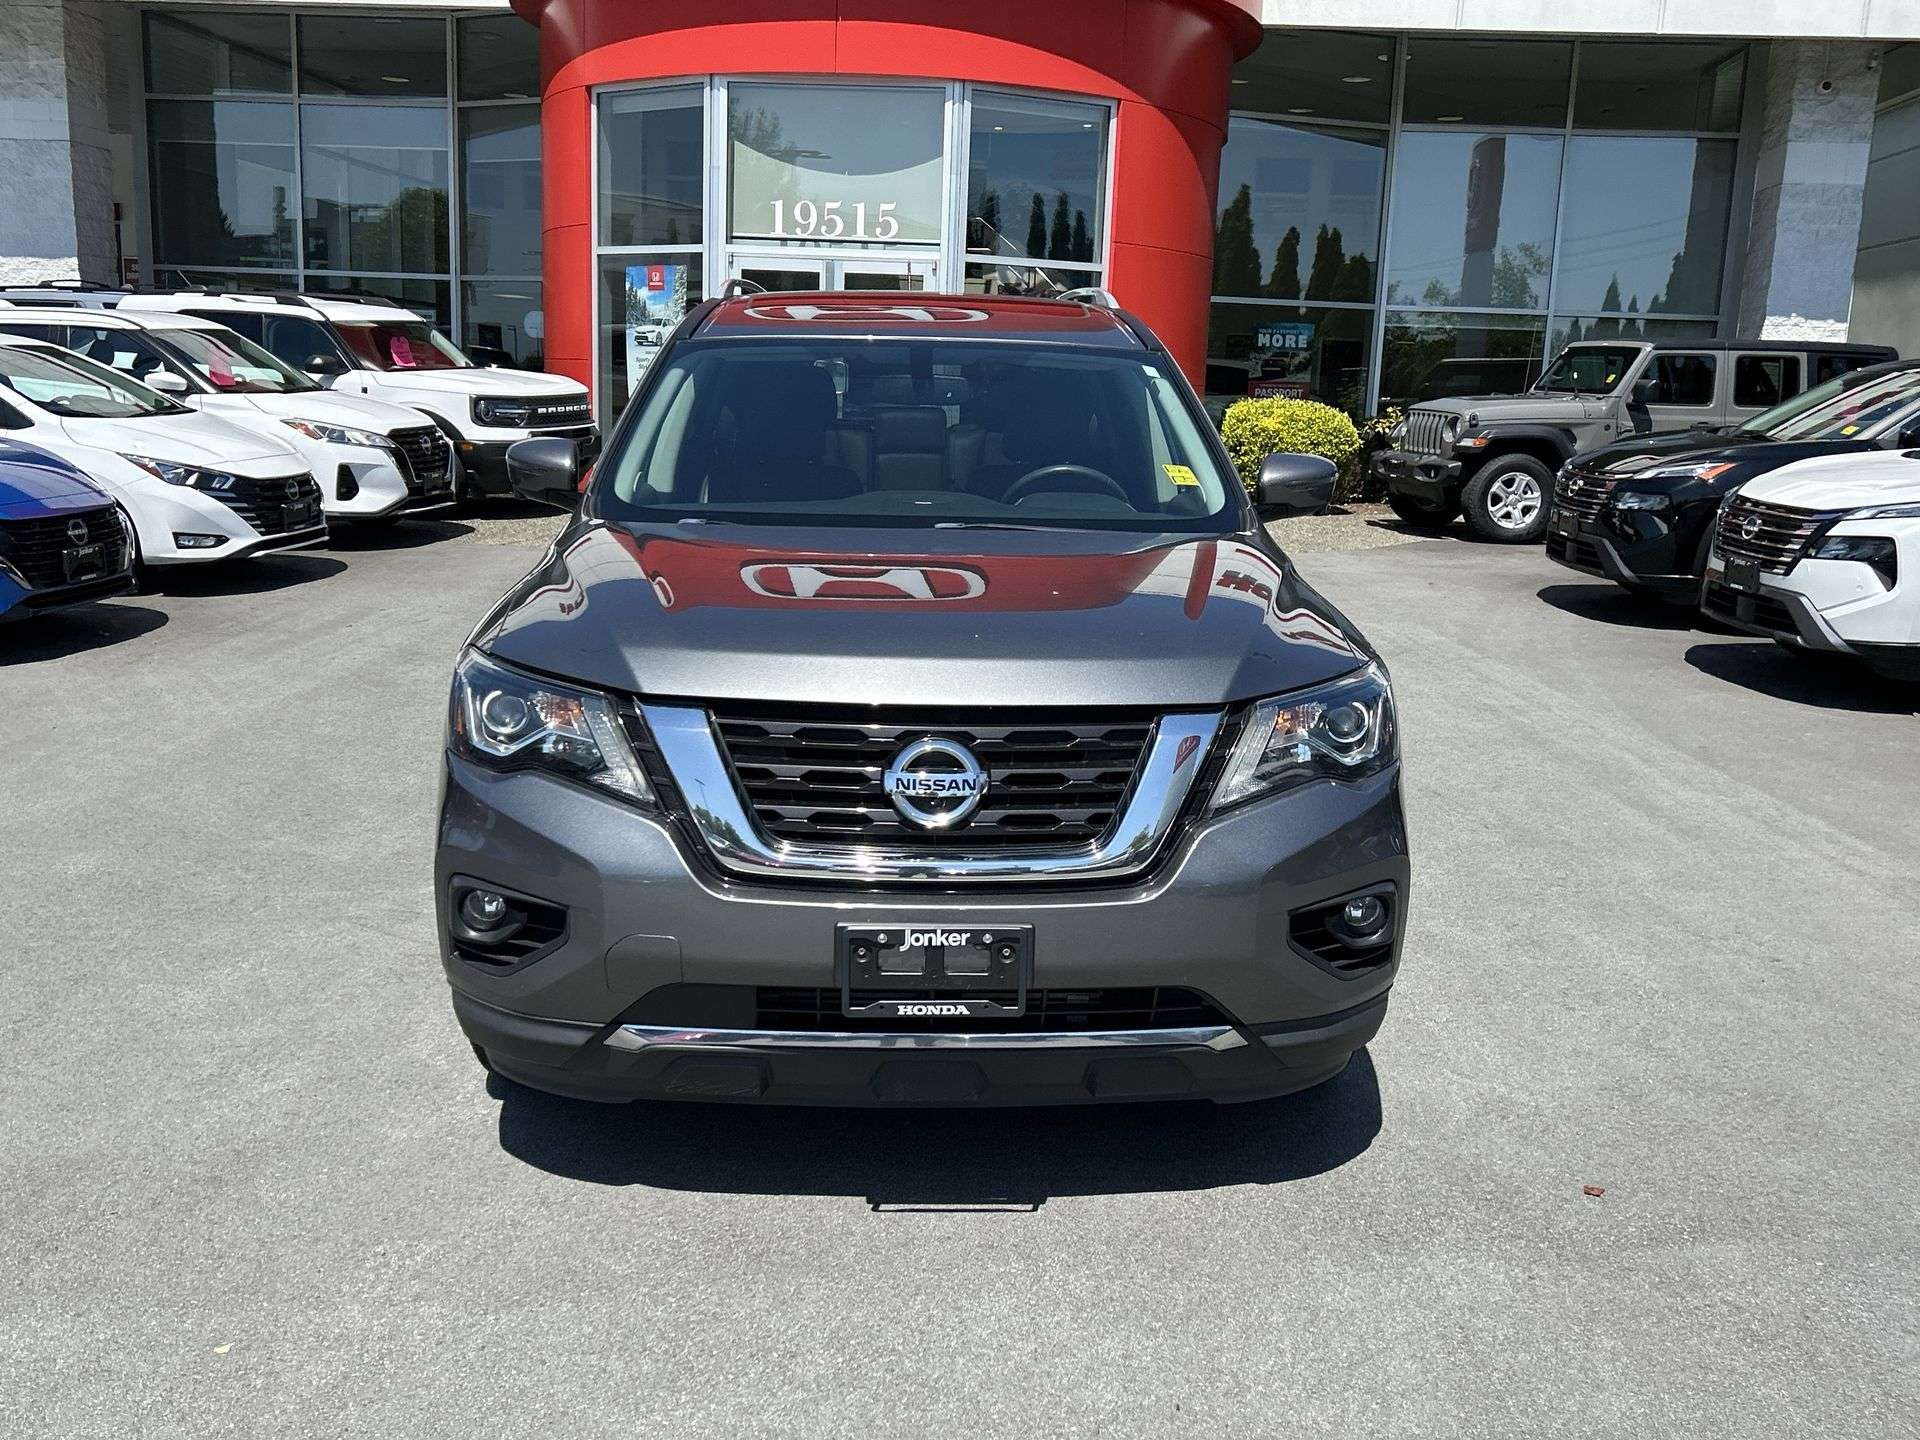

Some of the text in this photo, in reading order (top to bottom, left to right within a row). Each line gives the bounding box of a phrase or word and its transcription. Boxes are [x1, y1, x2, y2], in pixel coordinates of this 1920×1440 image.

[770, 199, 899, 239] 19515
[1257, 333, 1308, 348] MORE
[1254, 388, 1304, 398] PASSPORT
[537, 404, 587, 414] BRONCO
[895, 778, 977, 791] NISSAN
[899, 928, 971, 952] Jonker
[897, 1004, 971, 1016] HONDA
